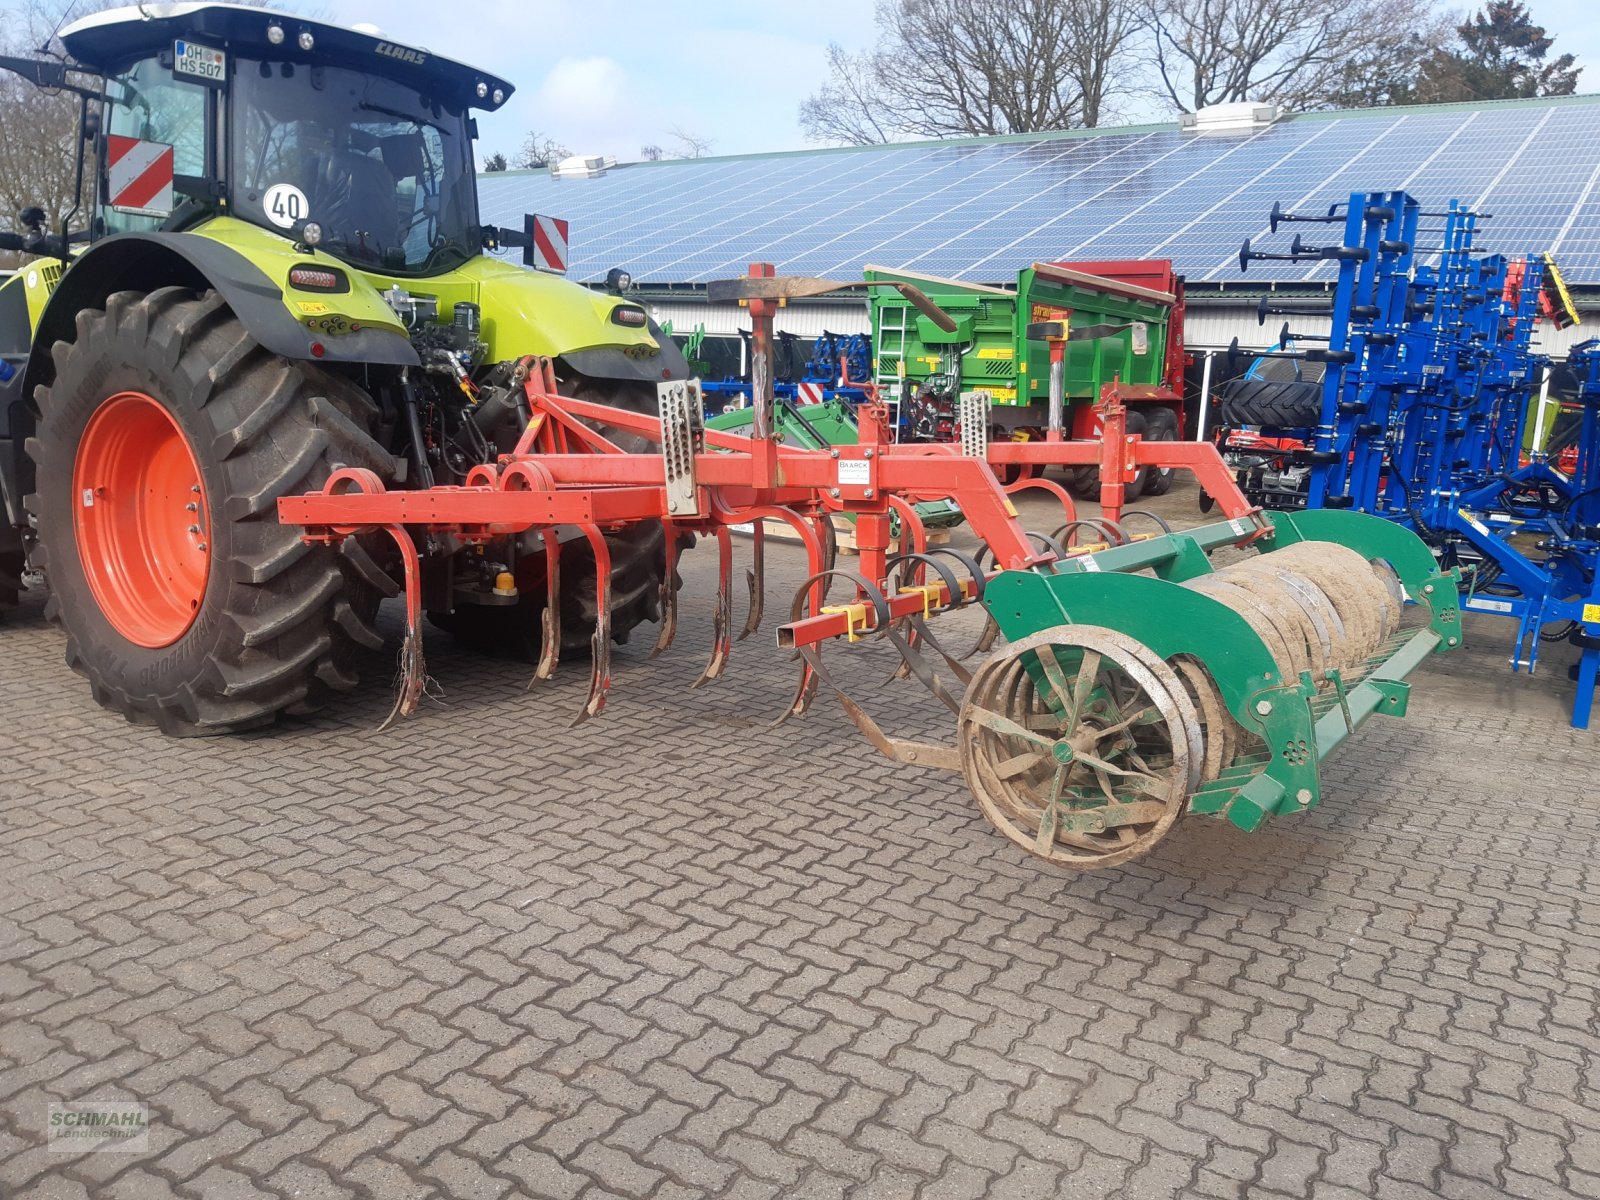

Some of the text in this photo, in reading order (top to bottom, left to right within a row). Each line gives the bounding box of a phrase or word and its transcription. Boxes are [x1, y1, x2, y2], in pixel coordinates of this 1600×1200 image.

[186, 45, 203, 60] OH
[374, 41, 426, 65] CLAAS
[180, 58, 221, 77] HS 507
[272, 192, 299, 219] 40
